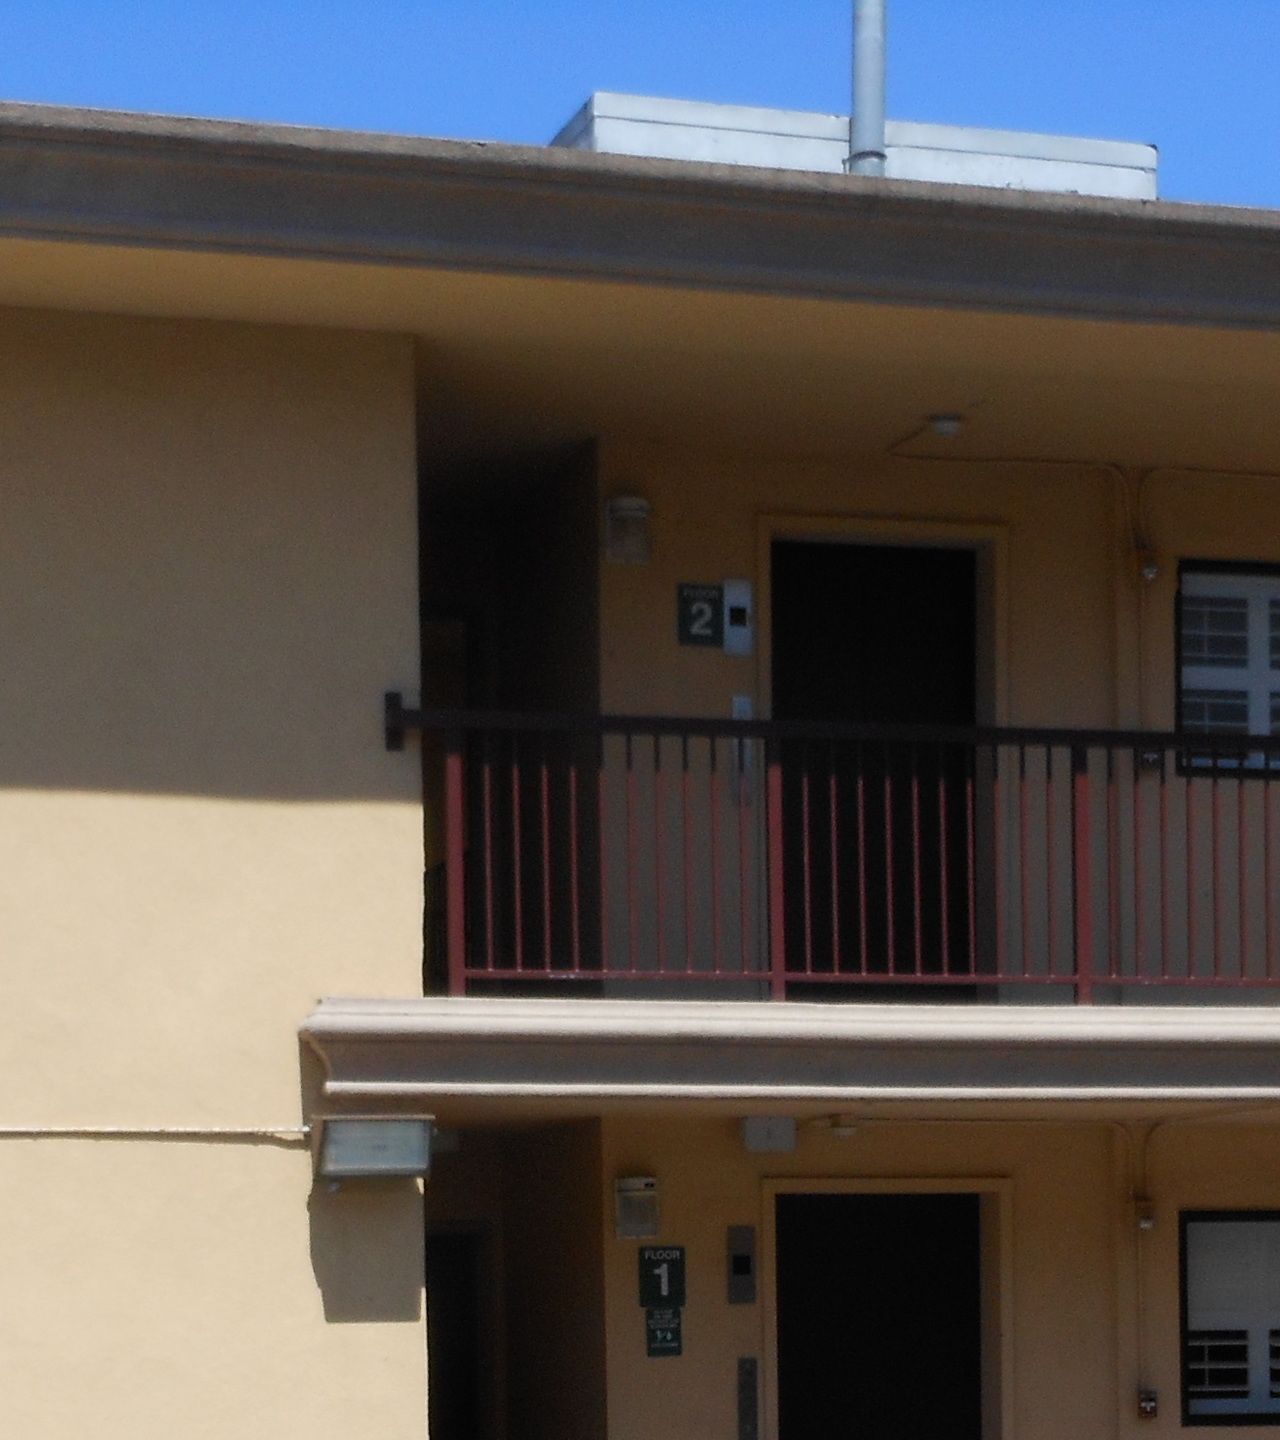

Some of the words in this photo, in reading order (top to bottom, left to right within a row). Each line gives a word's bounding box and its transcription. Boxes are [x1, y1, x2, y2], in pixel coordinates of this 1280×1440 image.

[690, 601, 713, 636] 2
[645, 1249, 681, 1260] FLOOR
[653, 1263, 669, 1296] 1
